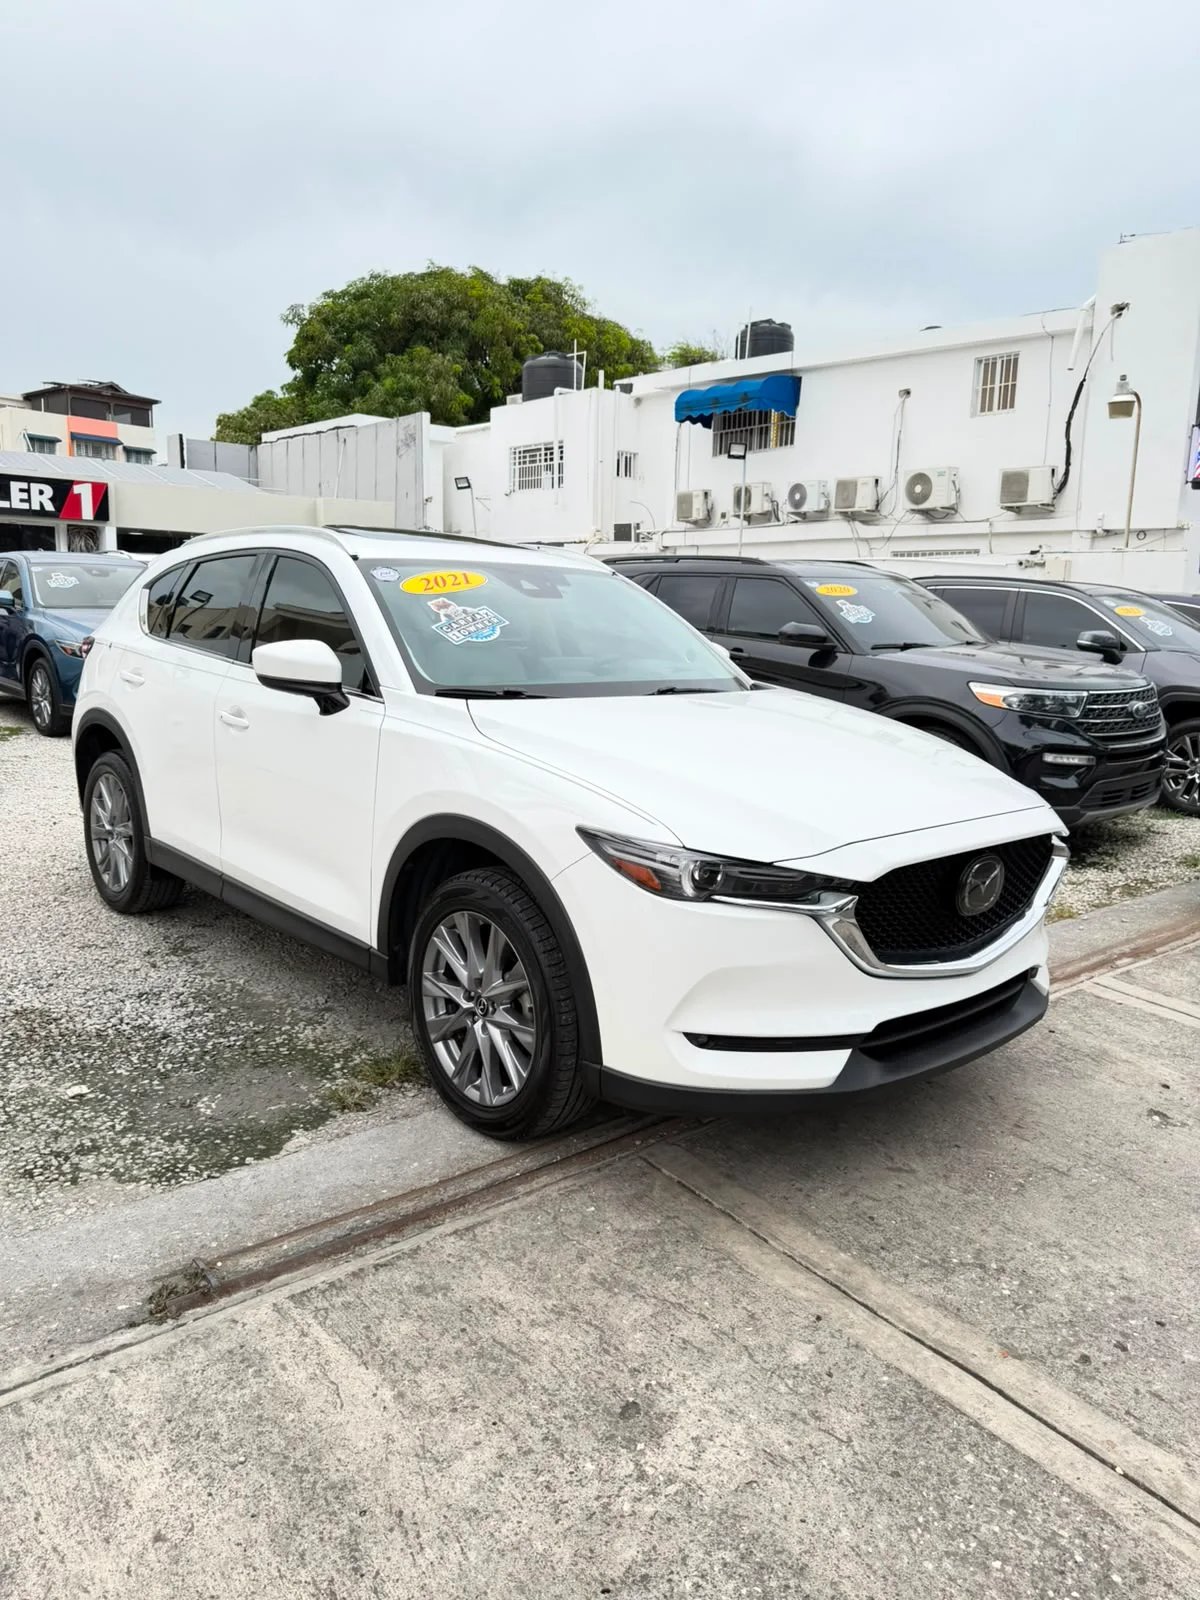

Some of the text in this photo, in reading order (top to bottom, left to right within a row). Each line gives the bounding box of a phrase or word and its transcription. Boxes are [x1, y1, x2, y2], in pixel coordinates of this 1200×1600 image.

[73, 482, 94, 520] 1
[420, 572, 472, 592] 2021
[441, 609, 494, 633] CARFAX
[460, 617, 499, 636] OWNER
